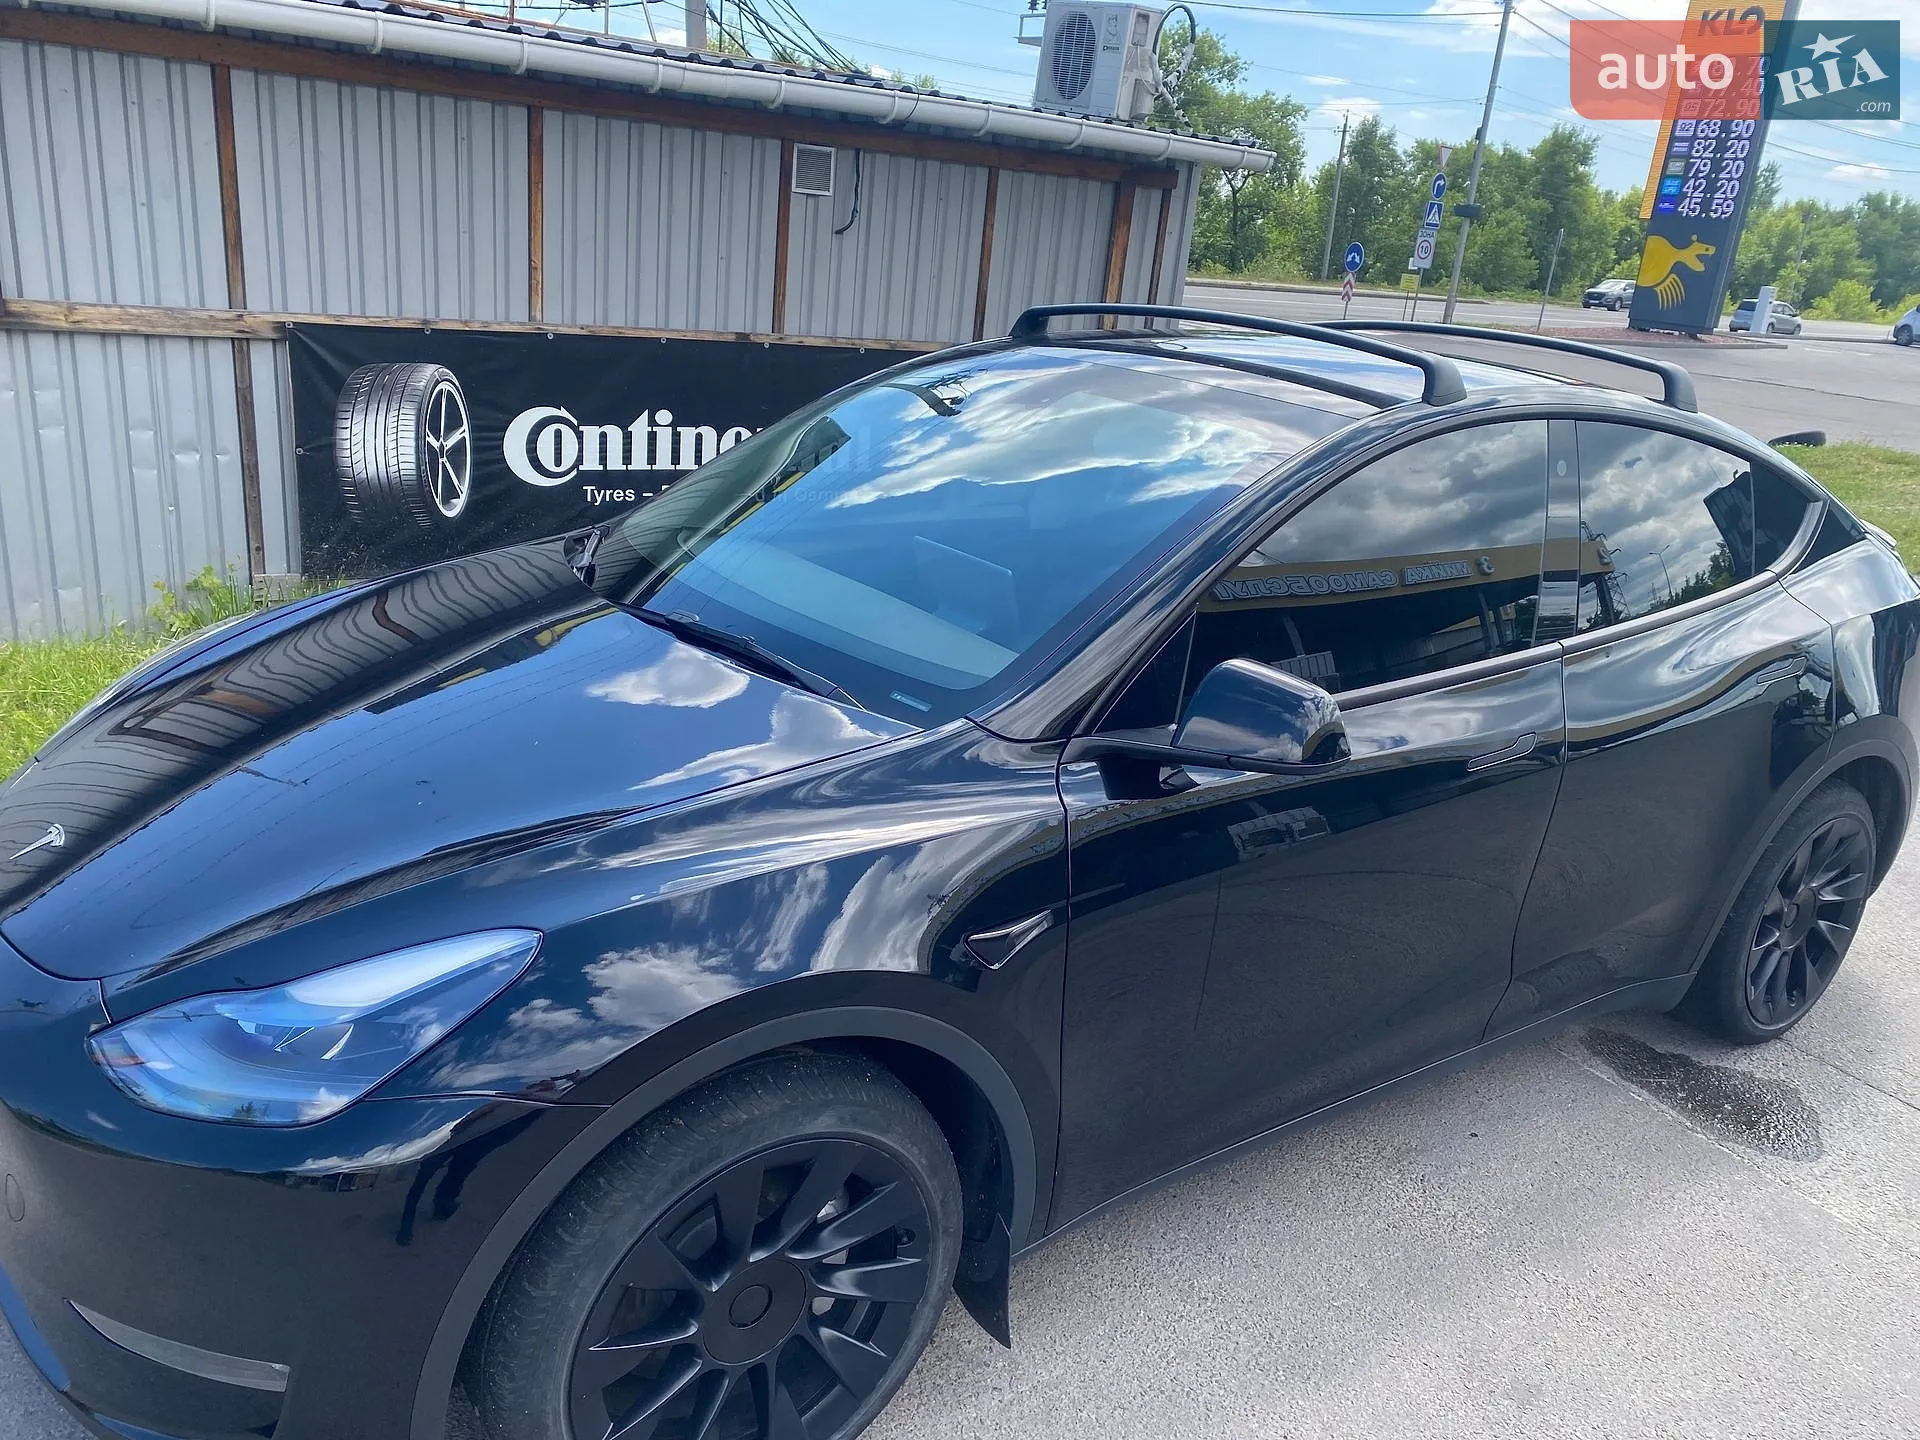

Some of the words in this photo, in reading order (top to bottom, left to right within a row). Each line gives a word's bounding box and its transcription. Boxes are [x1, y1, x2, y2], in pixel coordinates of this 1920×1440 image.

[1703, 99, 1760, 117] 72.90
[1696, 120, 1755, 138] 68.90
[1691, 140, 1750, 158] 82.20
[1688, 159, 1745, 178] 79.20
[1683, 179, 1740, 198] 42.20
[1678, 198, 1735, 219] 45.59
[583, 486, 635, 506] Tyres
